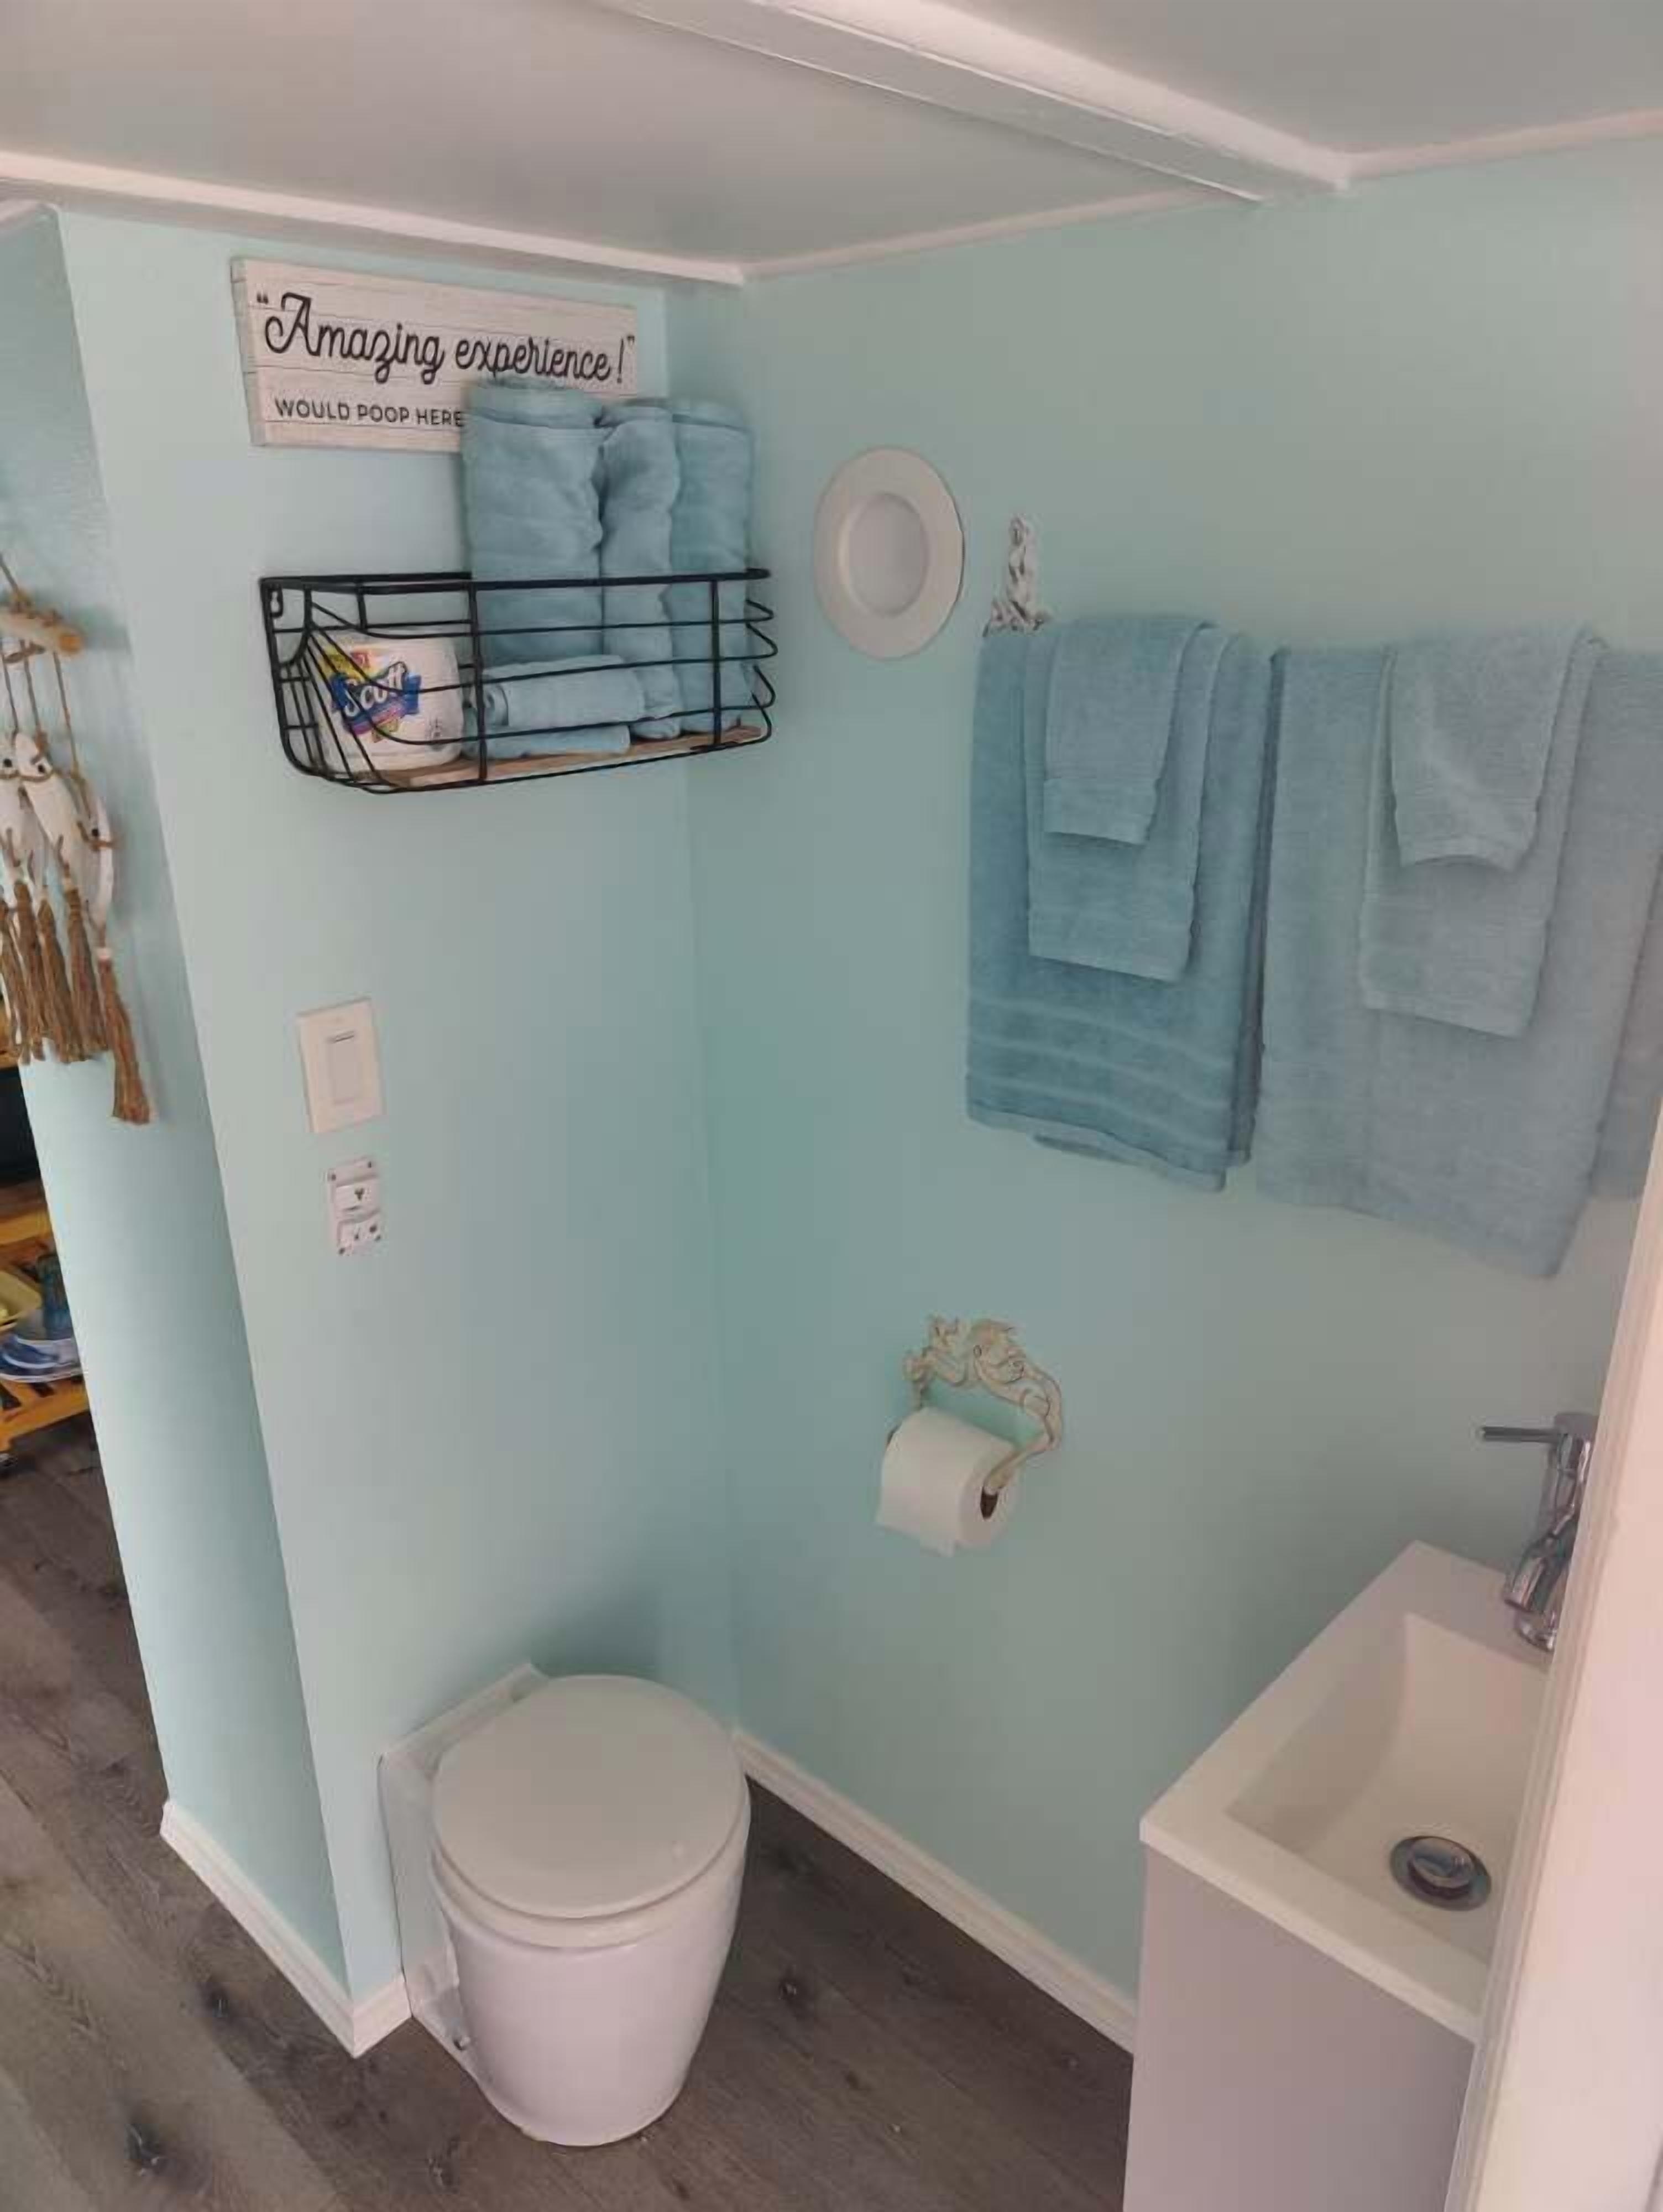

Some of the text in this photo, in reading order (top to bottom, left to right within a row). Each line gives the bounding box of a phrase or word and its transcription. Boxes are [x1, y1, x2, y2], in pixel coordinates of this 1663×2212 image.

[274, 398, 464, 427] WOULD POOP HERE
